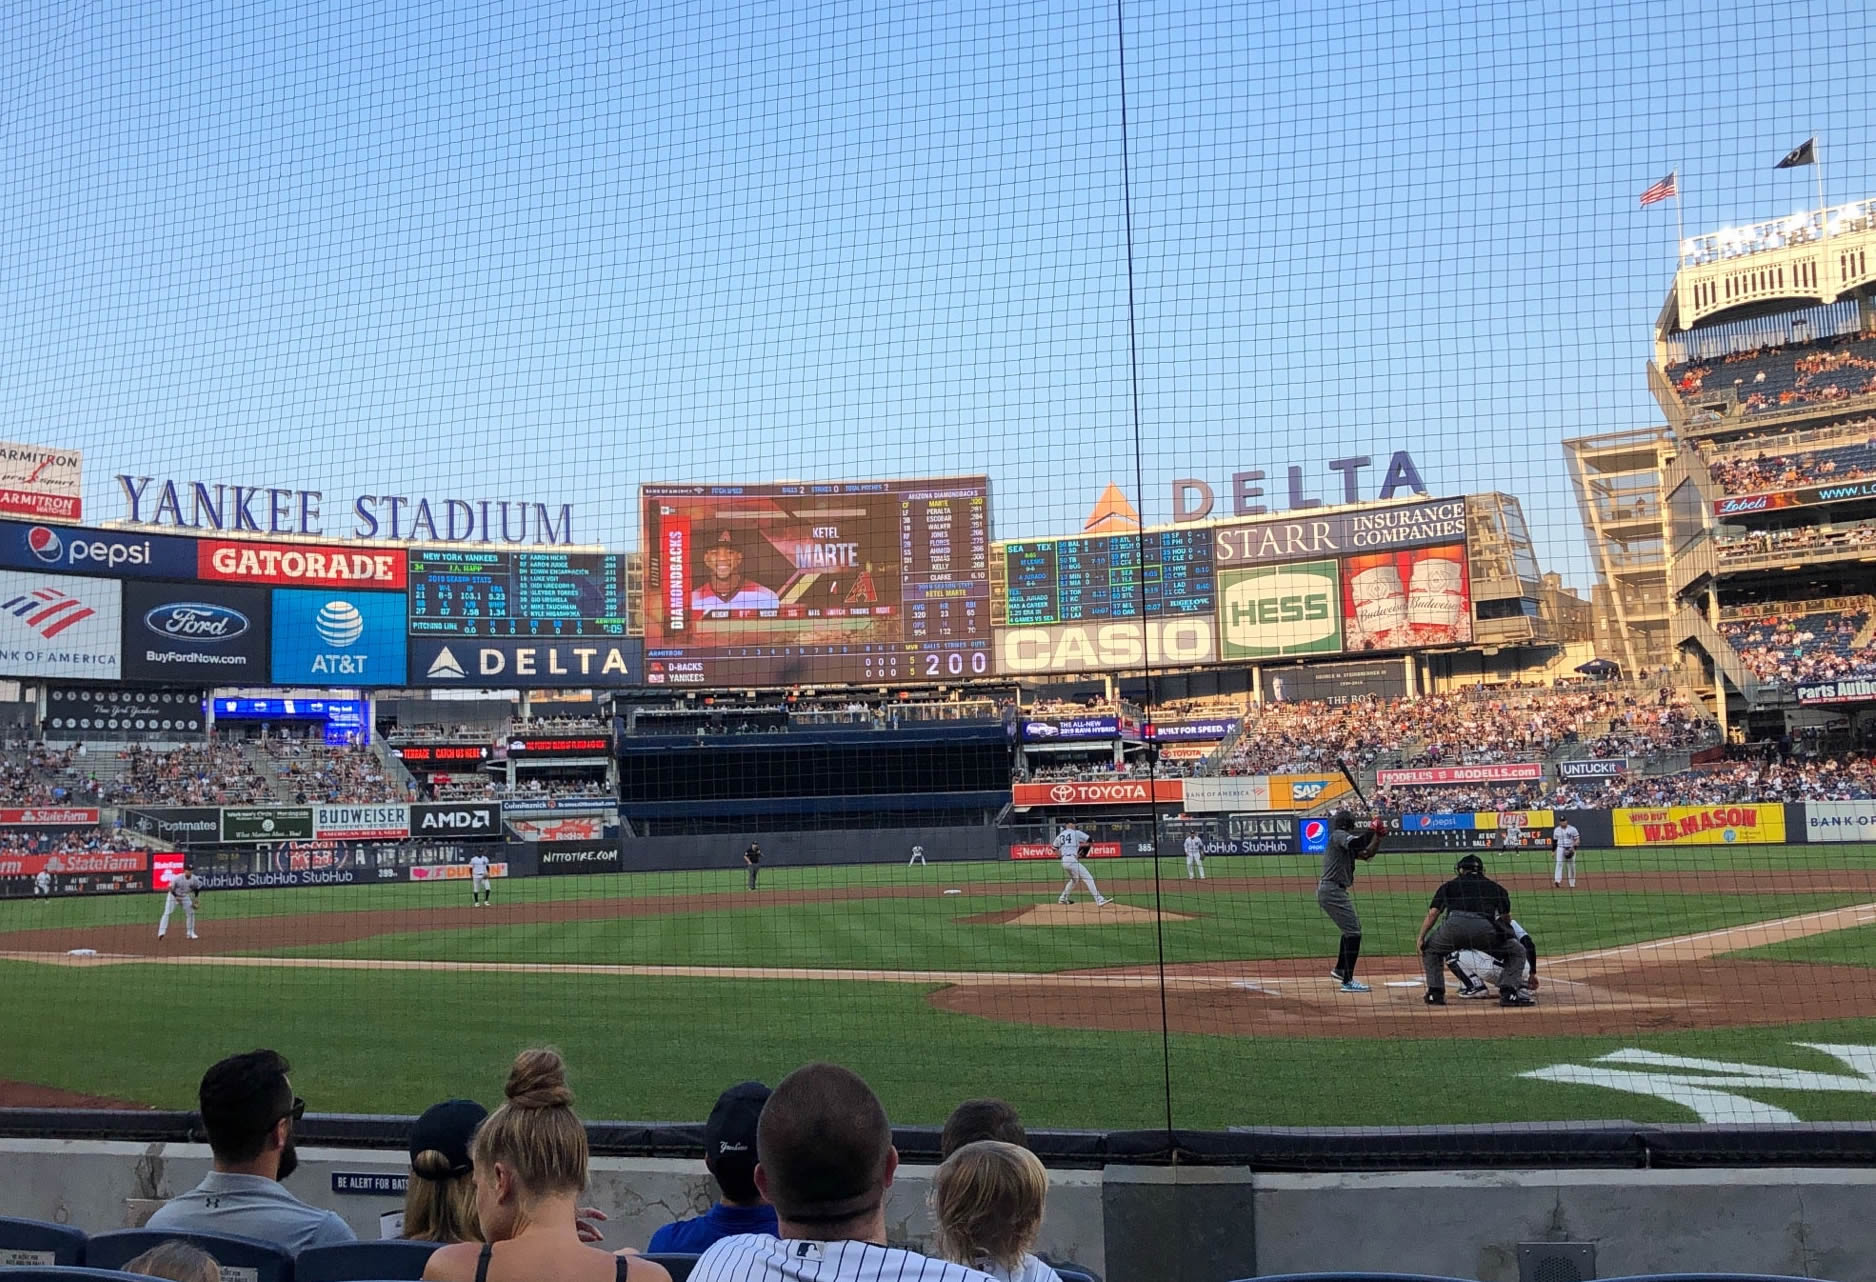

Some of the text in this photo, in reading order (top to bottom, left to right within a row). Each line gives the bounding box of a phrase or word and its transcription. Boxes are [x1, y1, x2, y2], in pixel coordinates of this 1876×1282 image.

[0, 449, 77, 467] ARMITRON
[833, 485, 839, 493] 0
[1172, 450, 1427, 523] DELTA
[2, 492, 74, 510] ARMITRON
[934, 490, 978, 498] DIAMONDBACKS
[37, 506, 72, 515] WATCHES
[114, 474, 574, 546] YANKEE STADIUM
[1720, 495, 1767, 513] Lobel's
[1352, 502, 1465, 532] INSURANCE
[813, 526, 840, 539] KETEL
[1353, 519, 1465, 547] COMPANIES
[1008, 543, 1052, 553] SEA TEX
[1216, 521, 1339, 561] STARR
[69, 541, 152, 567] pepsi
[423, 552, 498, 562] NEW YORK YANKEES
[795, 543, 859, 569] MARTE
[212, 548, 393, 581] GATORADE
[669, 531, 684, 630] DIAMONDBACKS
[460, 592, 481, 600] 103.1
[1170, 598, 1210, 607] BIGELOW
[1231, 593, 1328, 627] HESS
[165, 605, 228, 636] Ford
[412, 622, 442, 630] PITCHING
[1004, 618, 1211, 671] CASIO
[25, 652, 117, 665] OF AMERICA
[146, 650, 246, 666] BuyFordNow.com
[648, 649, 683, 657] ARMITRON
[311, 654, 367, 674] AT&T
[480, 648, 628, 675] DELTA
[668, 657, 896, 671] D-BACKS 0 0 0
[926, 652, 986, 675] 2 0 0
[668, 668, 897, 682] YANKEES 0 0 0
[1797, 685, 1836, 699] Parts
[1327, 695, 1347, 705] THE
[93, 704, 160, 717] New York Yankees
[1073, 720, 1102, 728] ALL-NEW
[1158, 725, 1225, 735] BUILT FOR SPEED.
[436, 748, 454, 759] CATCH
[456, 748, 464, 758] US
[1172, 750, 1201, 758] TOYOTA
[1564, 762, 1617, 775] UNTUCKit
[1382, 768, 1535, 784] MODELL'S MODELLS.com
[1077, 784, 1147, 800] TOYOTA
[1186, 791, 1206, 799] BANK
[1293, 784, 1322, 799] SAP
[319, 808, 405, 824] BUDWEISER
[421, 812, 471, 829] AMD
[1432, 817, 1456, 827] pepsi
[1629, 811, 1668, 822] WHO BUT
[1810, 816, 1853, 827] BANK
[158, 820, 217, 831] Postmates
[1060, 833, 1072, 845] 34
[1242, 840, 1287, 853] StubHub
[543, 849, 617, 864] NITTOTIRE.COM
[247, 872, 298, 886] StubHub
[302, 869, 353, 883] StubHub
[378, 869, 393, 878] 399
[338, 1177, 348, 1188] BE
[350, 1177, 373, 1189] ALERT
[375, 1178, 390, 1189] FOR
